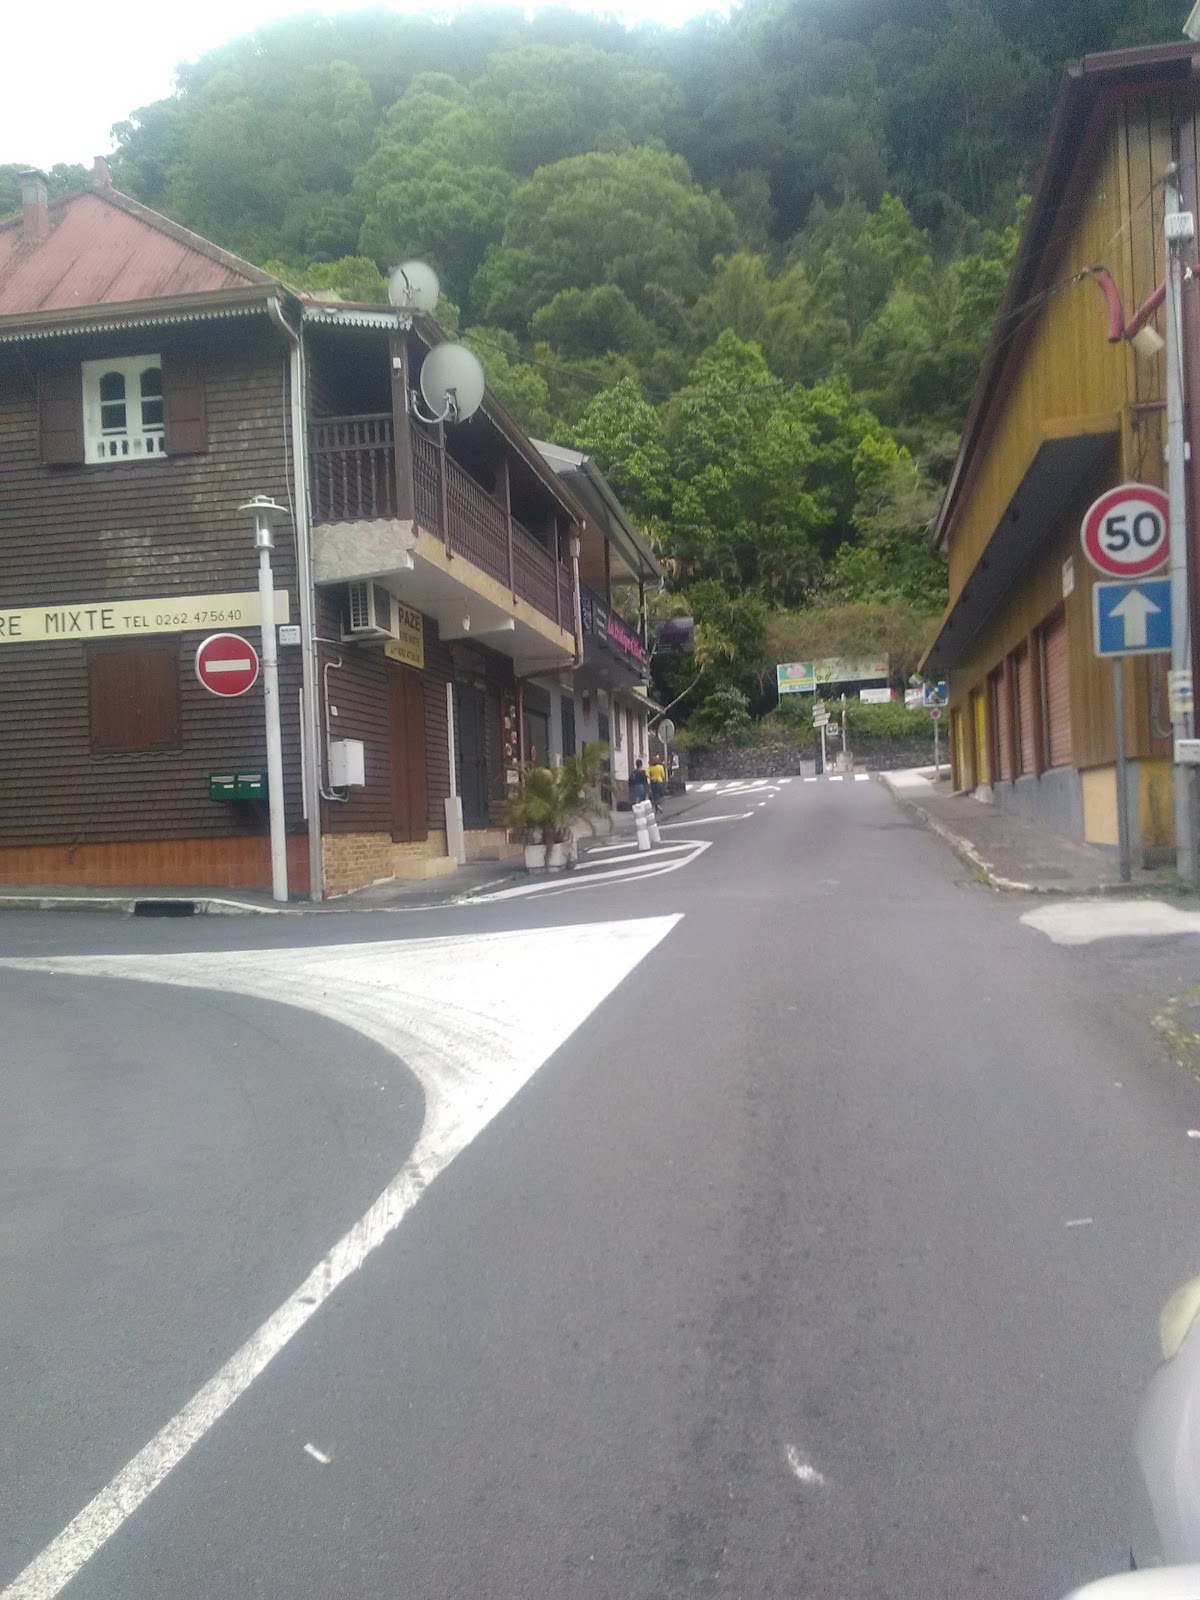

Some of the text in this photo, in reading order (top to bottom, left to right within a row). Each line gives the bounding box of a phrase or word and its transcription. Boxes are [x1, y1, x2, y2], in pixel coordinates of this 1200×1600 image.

[1106, 511, 1161, 552] 50
[45, 609, 115, 633] MIXTE
[122, 616, 150, 628] TEL
